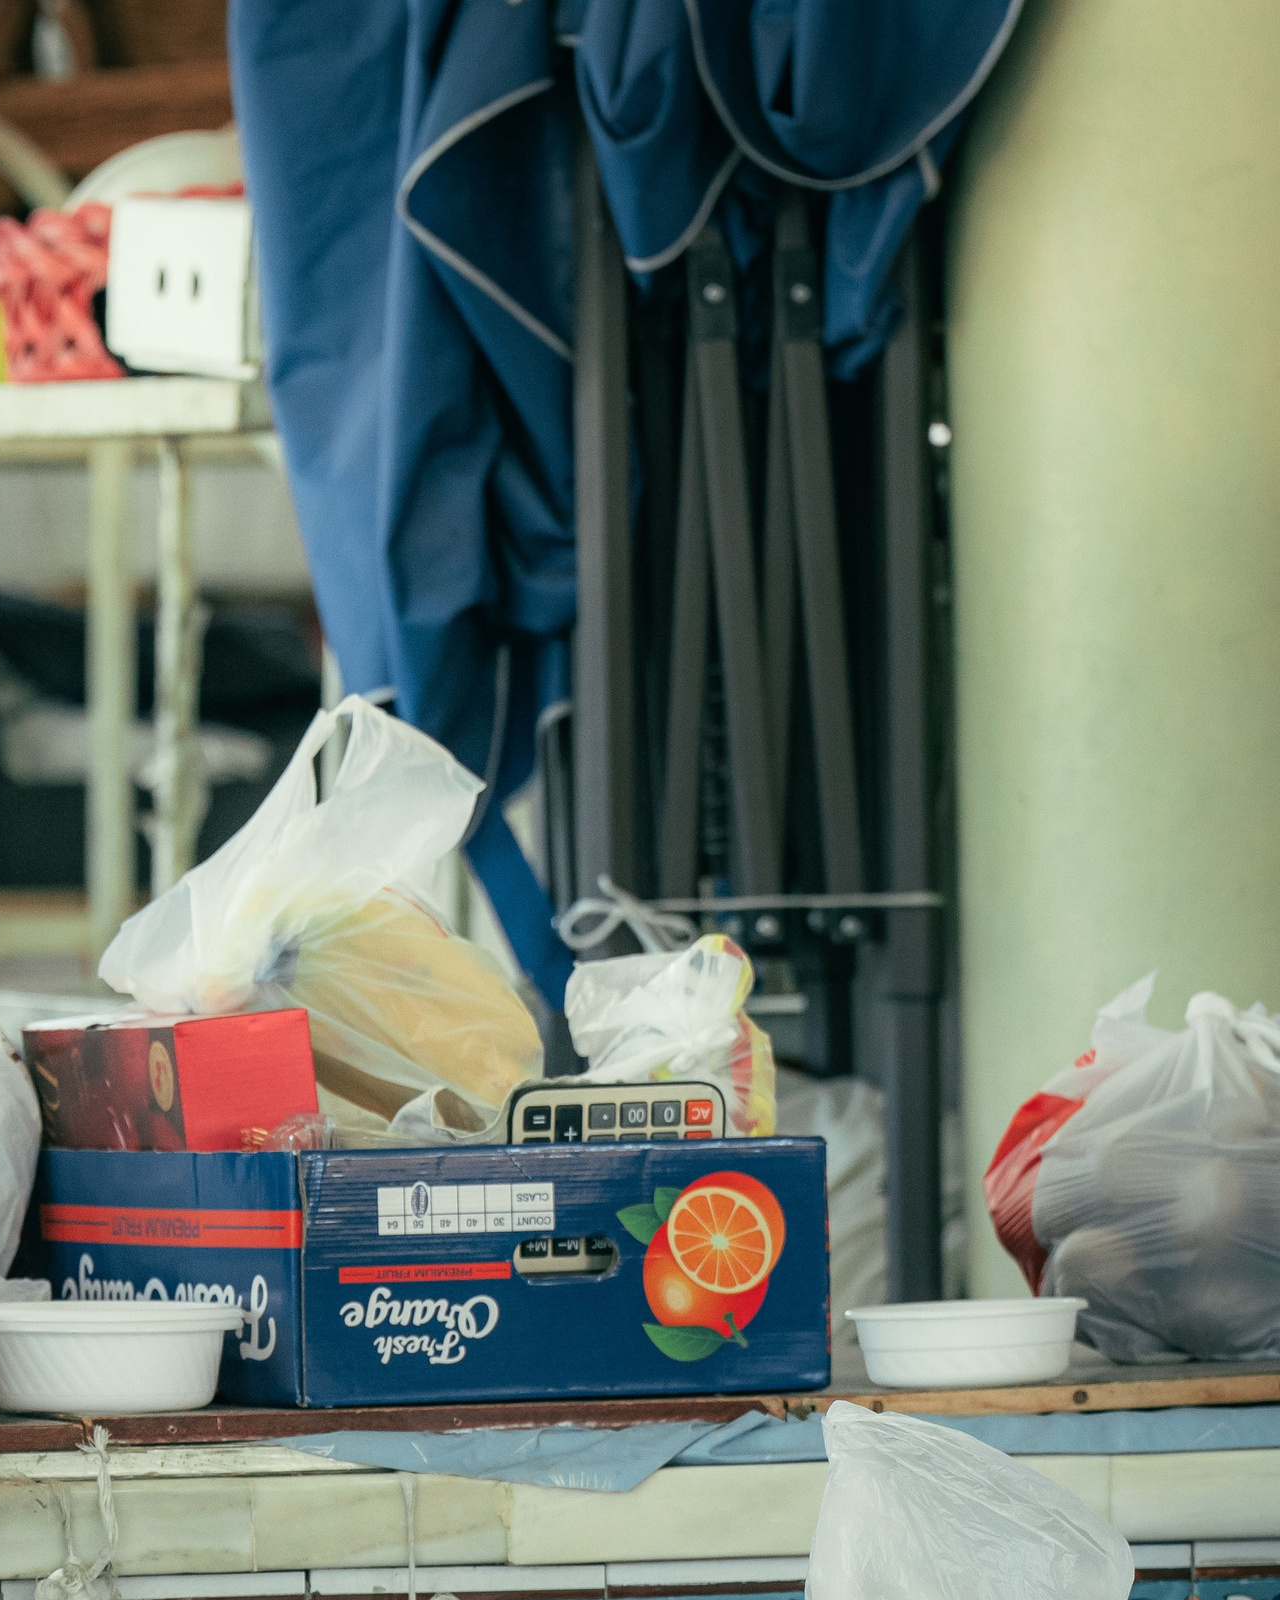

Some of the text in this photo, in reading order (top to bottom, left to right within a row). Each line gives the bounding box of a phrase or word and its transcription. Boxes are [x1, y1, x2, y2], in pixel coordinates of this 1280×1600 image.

[691, 1107, 710, 1120] AC
[516, 1192, 549, 1203] CLASS
[387, 1216, 552, 1230] COUNT 30 40 48 56 64
[374, 1266, 473, 1280] PREMIUM FRUIT
[339, 1286, 501, 1339] Orange
[373, 1330, 467, 1365] Fresh
